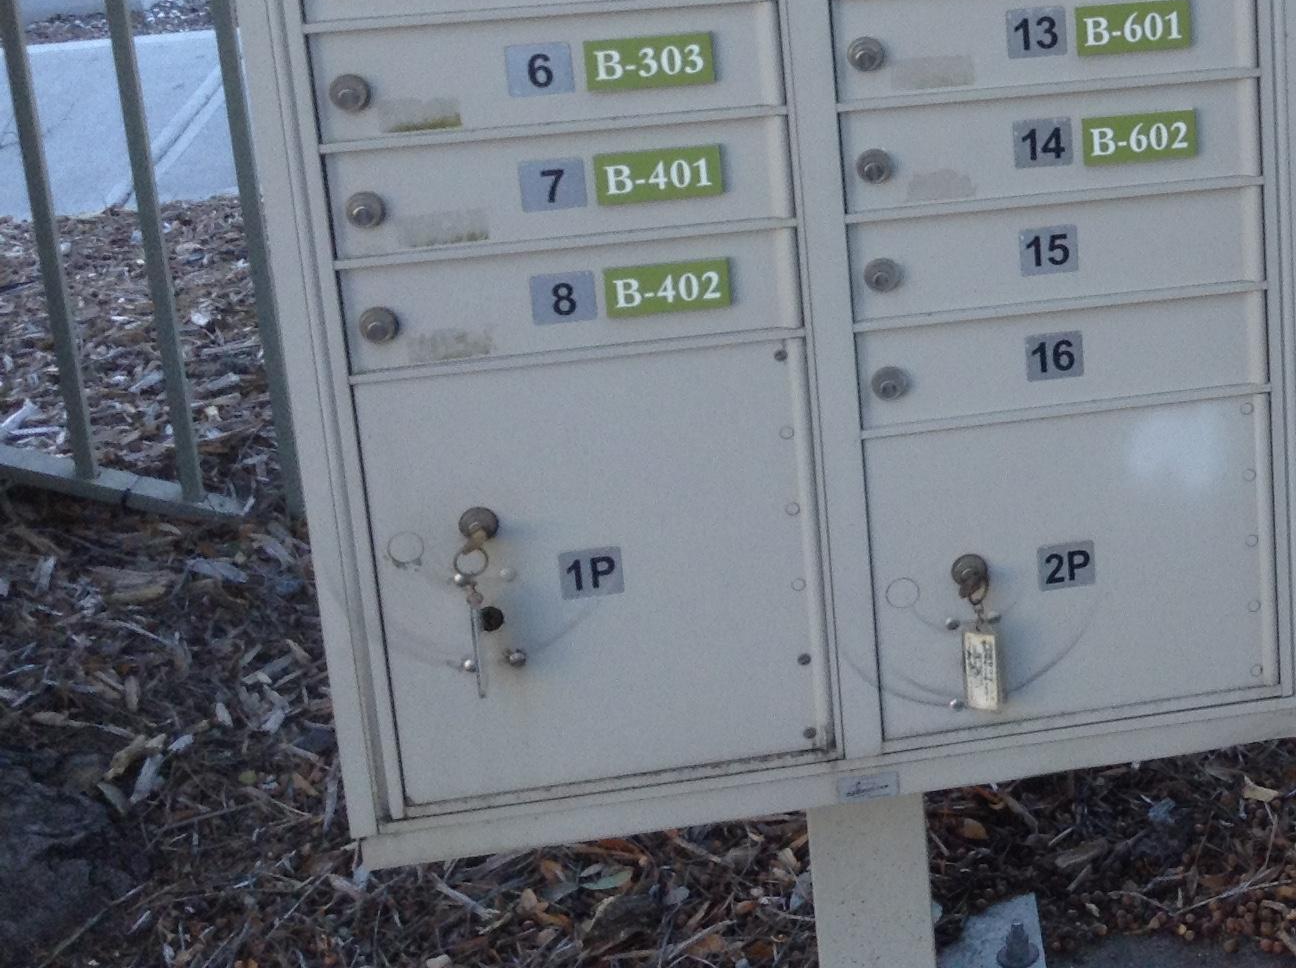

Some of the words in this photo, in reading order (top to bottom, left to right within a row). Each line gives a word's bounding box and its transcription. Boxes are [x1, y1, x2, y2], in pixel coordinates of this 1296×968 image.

[1014, 15, 1059, 51] 13
[1083, 11, 1182, 46] B-601
[527, 53, 554, 89] 6
[594, 44, 705, 81] B-303
[1021, 126, 1066, 161] 14
[1090, 121, 1189, 156] B-602
[540, 168, 565, 204] 7
[604, 157, 712, 195] B-401
[1025, 233, 1070, 267] 15
[551, 282, 577, 316] 8
[612, 271, 721, 308] B-402
[1031, 339, 1076, 373] 16
[566, 555, 616, 592] 1P
[1045, 549, 1091, 585] 2P
